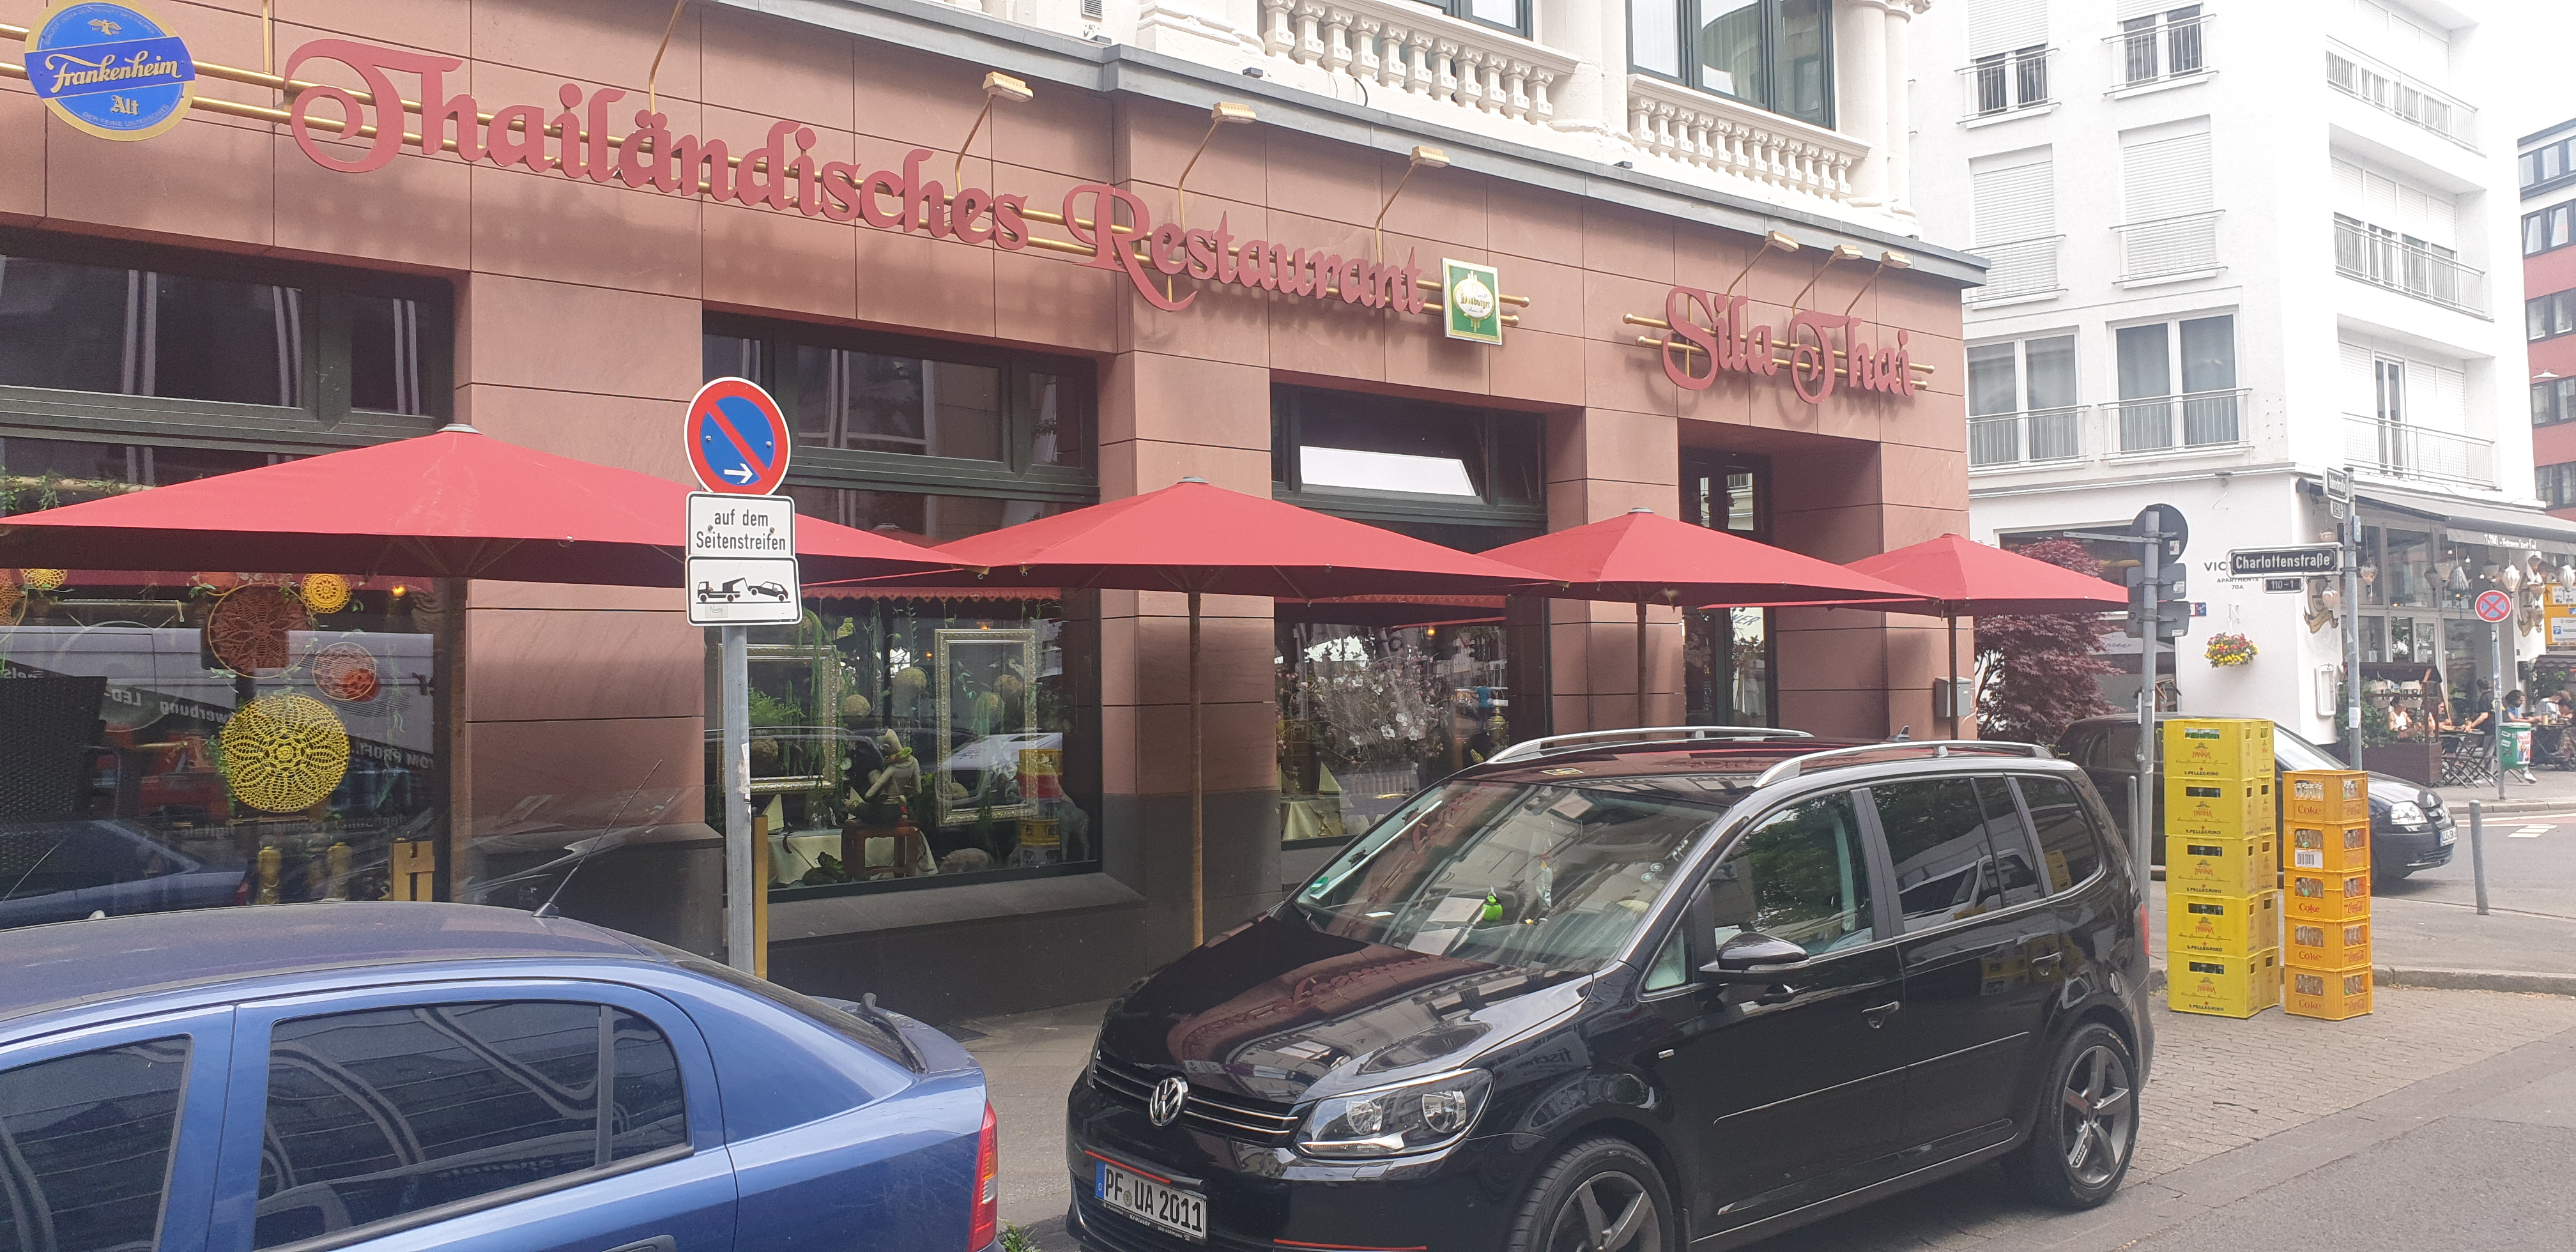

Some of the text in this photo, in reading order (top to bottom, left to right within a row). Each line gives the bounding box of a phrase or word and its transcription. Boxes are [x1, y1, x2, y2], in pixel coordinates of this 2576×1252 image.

[45, 50, 183, 94] Frankenheim
[110, 95, 140, 116] Alt
[285, 38, 1427, 315] Thailändisches Restaurant
[1662, 286, 1915, 404] Sila Thai
[714, 508, 769, 527] auf dem
[696, 531, 786, 551] Seitenstreifen
[2235, 553, 2331, 569] Charlottenstraße
[2297, 805, 2322, 814] Coke
[2299, 903, 2320, 913] Coke
[2299, 950, 2322, 961] Coke
[2298, 998, 2321, 1010] Coke
[1098, 1168, 1202, 1232] D PF UA 2011
